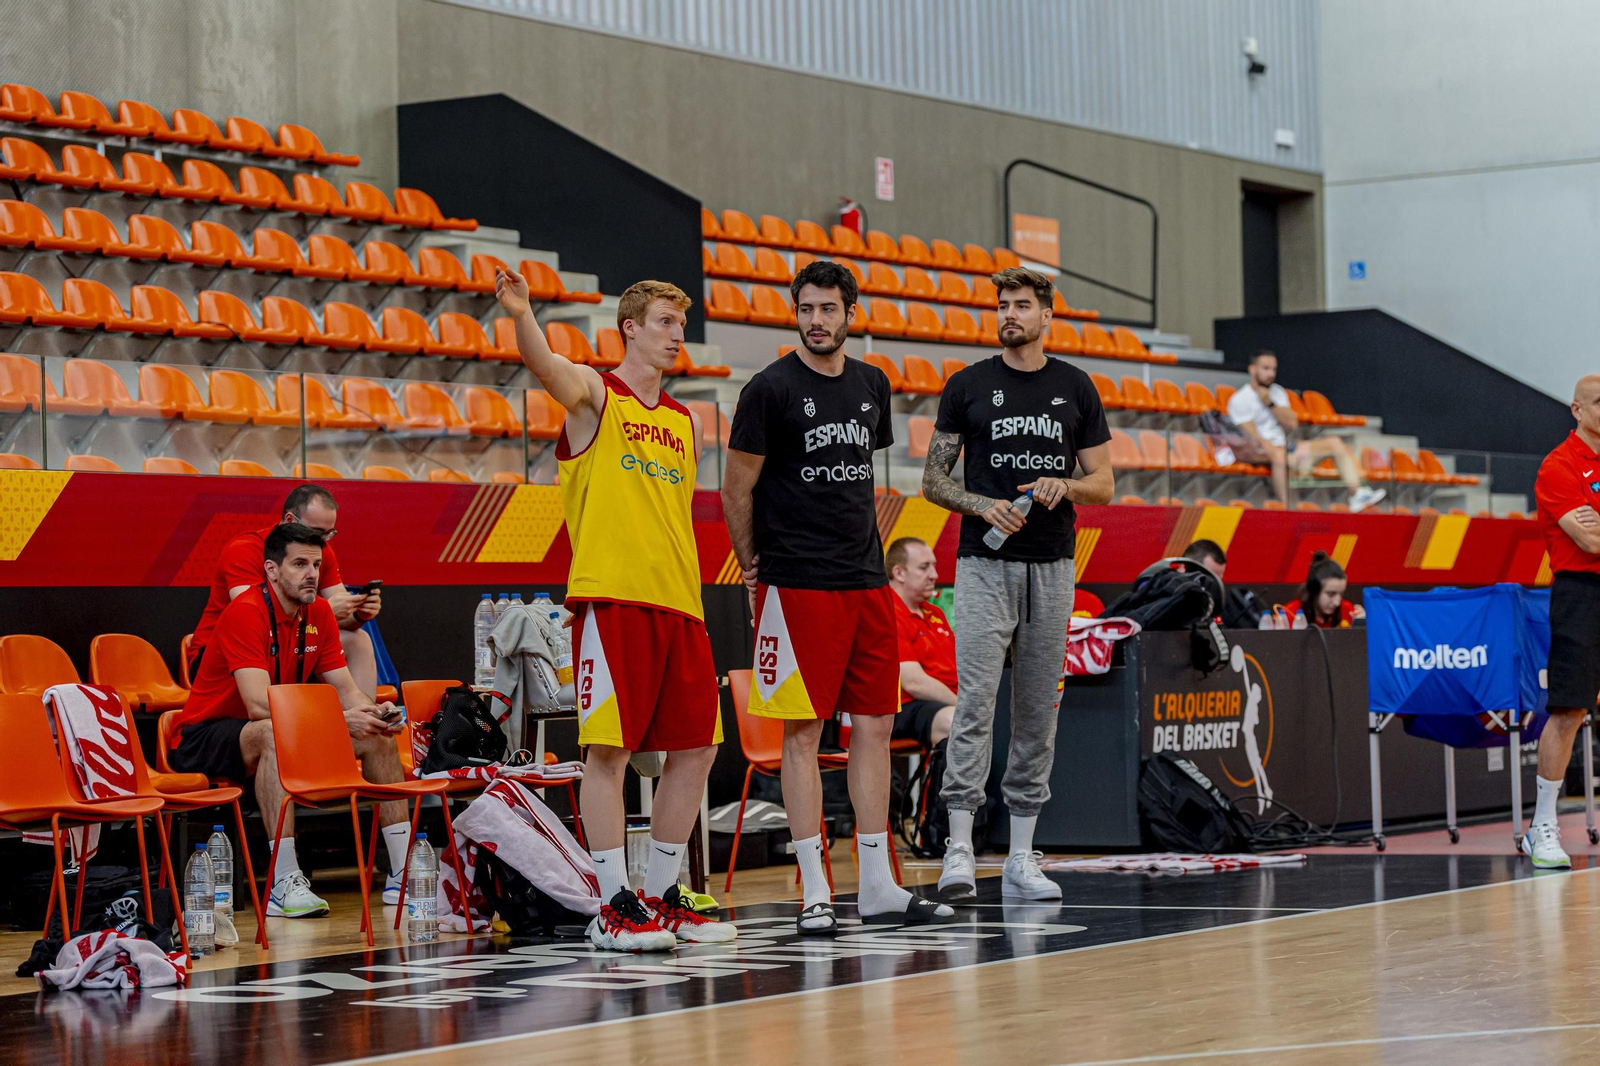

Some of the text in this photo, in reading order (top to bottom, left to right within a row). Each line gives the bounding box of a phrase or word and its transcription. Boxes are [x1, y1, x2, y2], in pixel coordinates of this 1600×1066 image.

[622, 421, 685, 460] ESPAÑA
[804, 418, 870, 453] ESPAÑA
[991, 414, 1063, 443] ESPAÑA
[620, 454, 684, 485] endes
[800, 460, 873, 482] endesa
[990, 450, 1066, 470] endesa
[759, 635, 779, 685] ESP
[1393, 643, 1488, 670] molten
[581, 658, 594, 710] ESP
[1153, 690, 1241, 723] L'ALQUERIA
[1153, 721, 1241, 753] DEL BASKET
